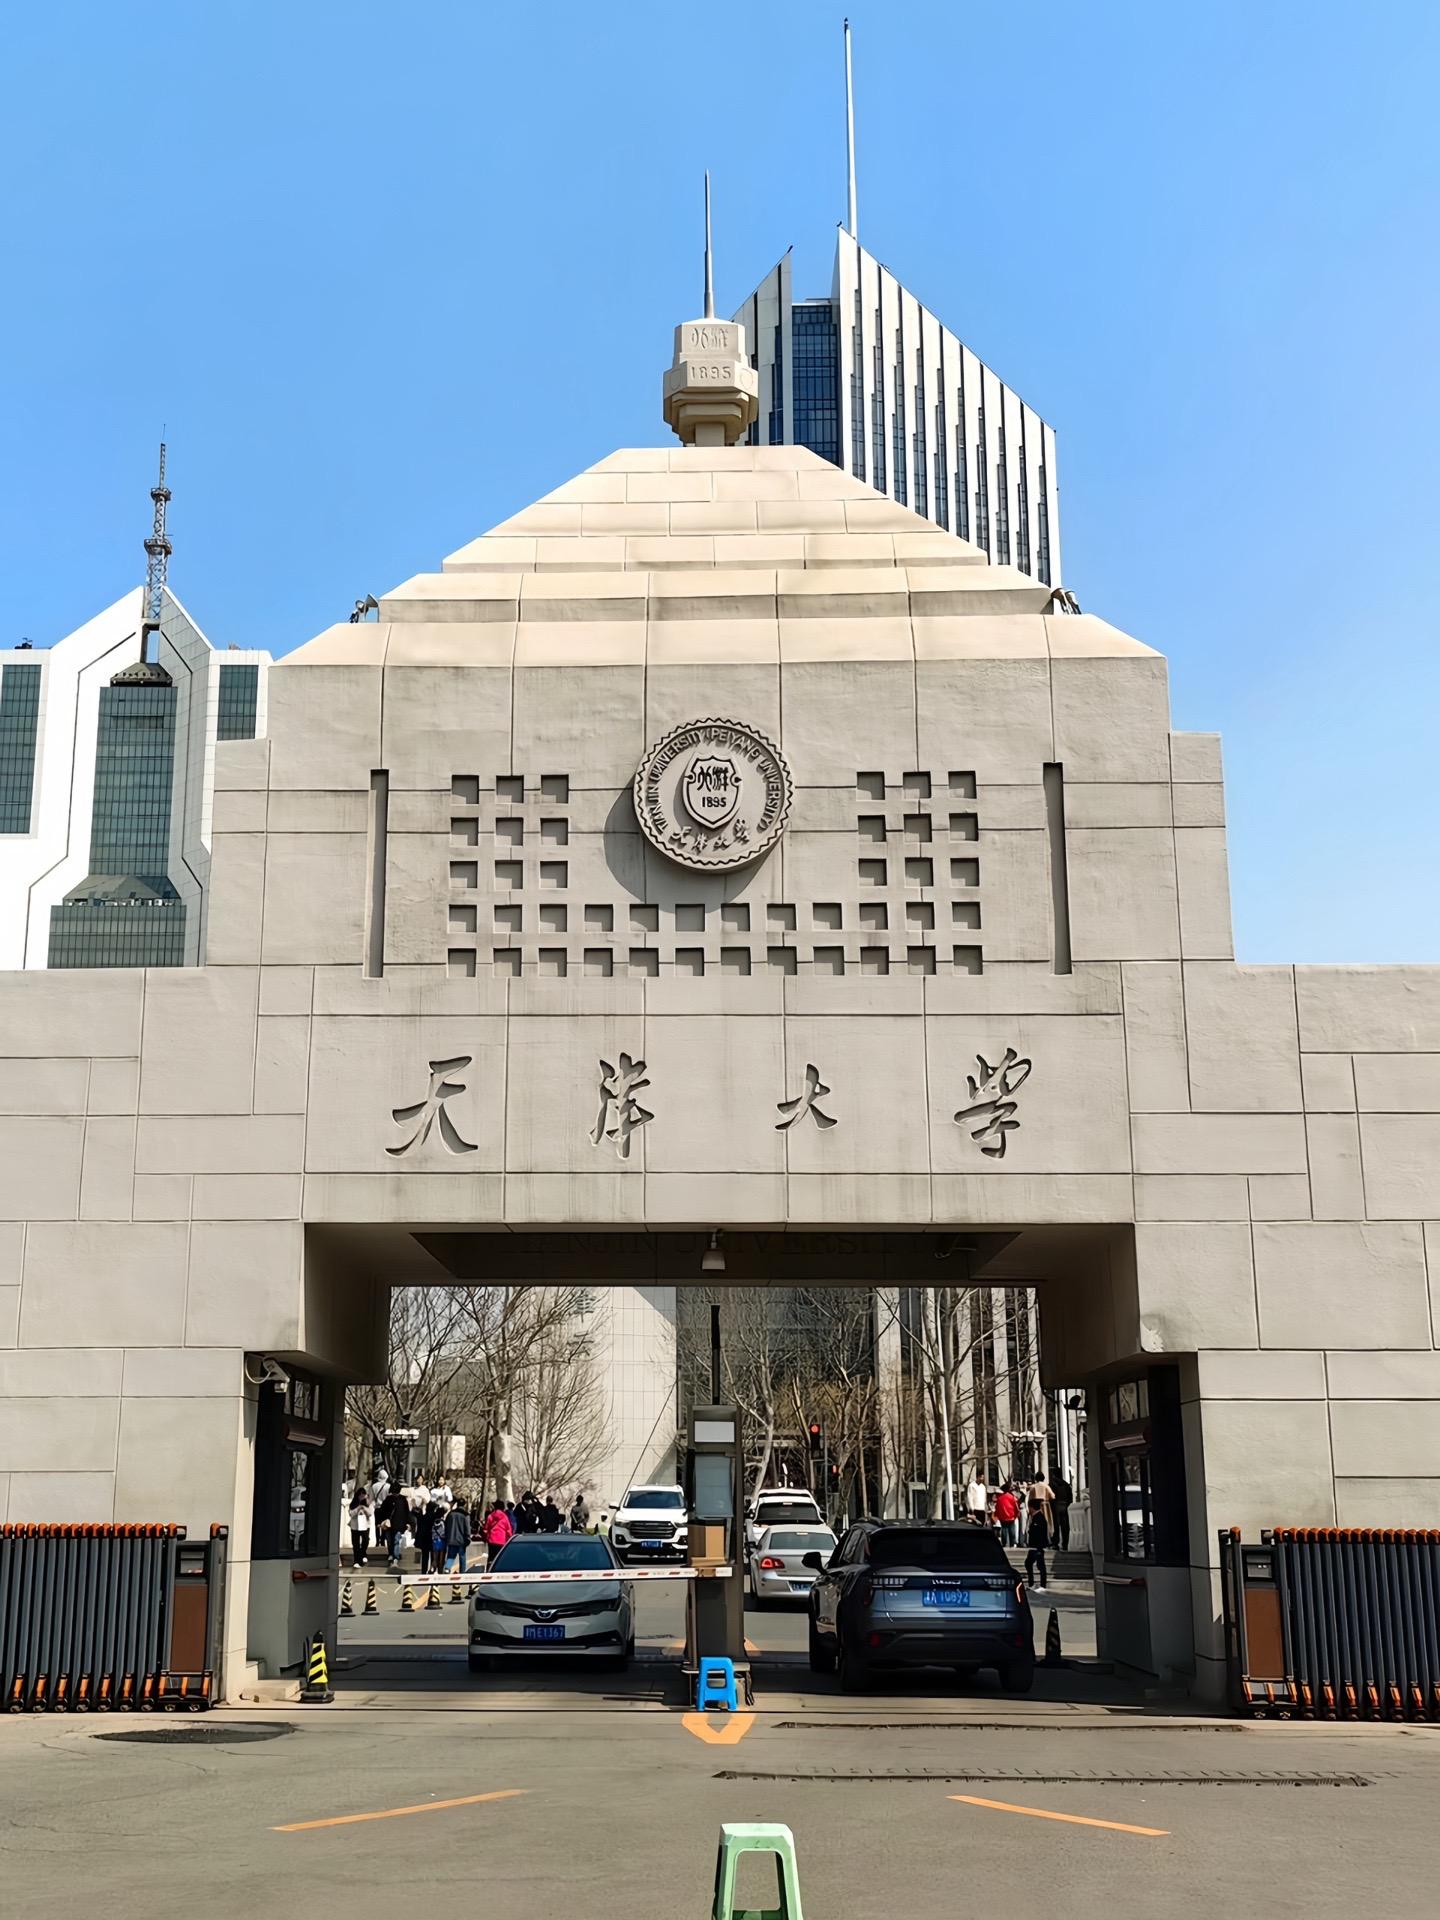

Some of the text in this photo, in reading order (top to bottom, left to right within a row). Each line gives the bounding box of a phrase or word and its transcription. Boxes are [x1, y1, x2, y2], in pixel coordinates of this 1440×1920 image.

[691, 366, 732, 379] 1895
[648, 728, 704, 781] UNIVERSITY
[647, 784, 669, 835] TIANJIN
[702, 796, 727, 808] 1895
[384, 1047, 1032, 1159] 天津大学
